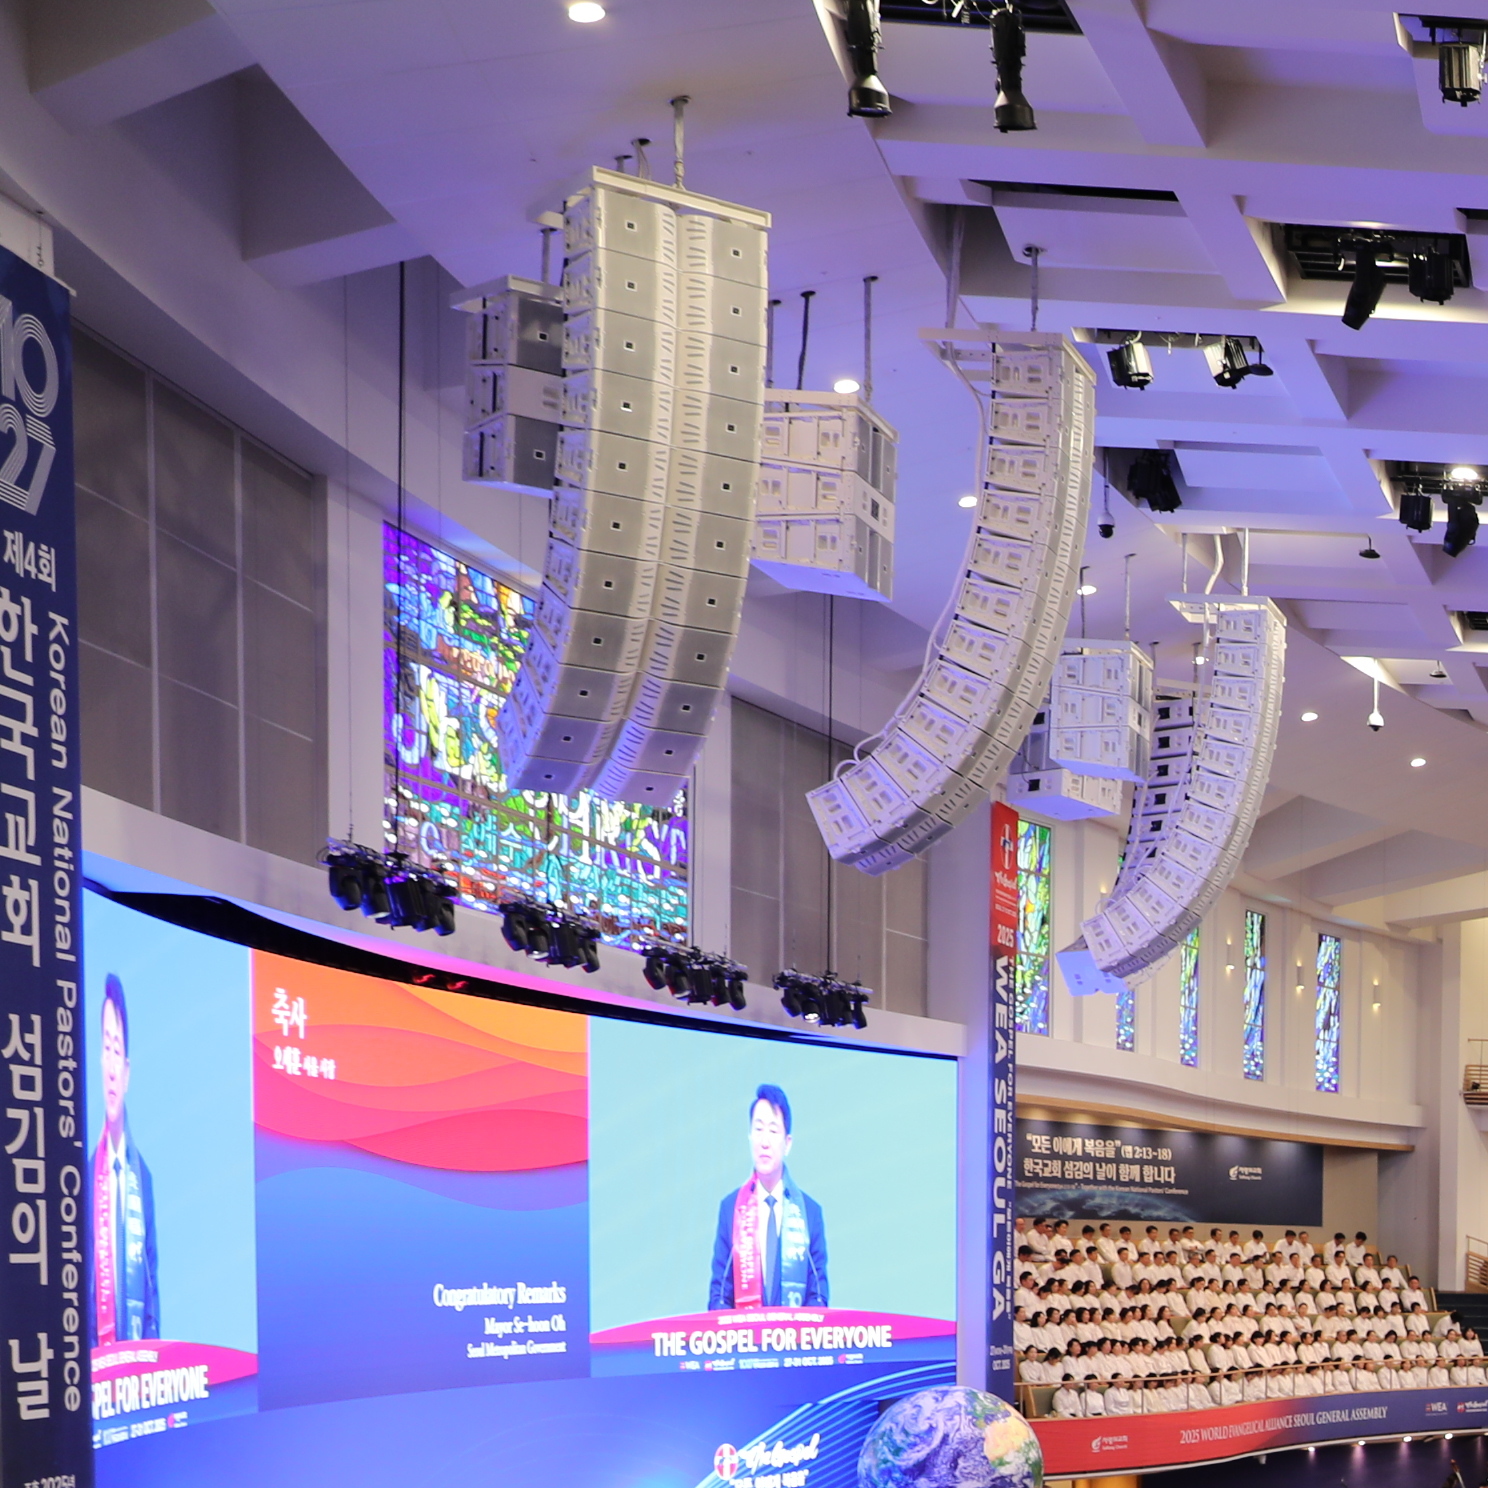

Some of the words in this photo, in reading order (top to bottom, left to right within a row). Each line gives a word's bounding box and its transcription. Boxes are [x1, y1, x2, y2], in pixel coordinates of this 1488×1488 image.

[4, 530, 56, 592] 제4회
[48, 611, 70, 769] Korean
[0, 586, 42, 967] 한국교회
[52, 787, 76, 962] National
[997, 923, 1015, 948] 2025
[271, 987, 308, 1039] 축사
[995, 955, 1008, 1064] WEA
[56, 979, 82, 1148] Pastors'
[2, 1013, 48, 1285] 섬김의
[993, 1077, 1007, 1238] SEOUL
[1006, 1101, 1014, 1190] EVERYONE
[1023, 1158, 1061, 1178] 한국교회
[1063, 1161, 1094, 1180] 섬김의
[1095, 1162, 1117, 1181] 날이
[1118, 1163, 1141, 1183] 함께
[1142, 1164, 1176, 1185] 합니다
[1052, 1136, 1083, 1156] 이에게
[59, 1165, 82, 1412] Conference
[433, 1283, 516, 1312] Congratulatory
[517, 1281, 567, 1305] Remarks
[992, 1250, 1005, 1321] GA
[9, 1333, 54, 1420] 날
[651, 1332, 687, 1357] THE
[689, 1328, 759, 1355] GOSPEL
[761, 1327, 798, 1352] FOR
[800, 1325, 893, 1351] EVERYONE
[115, 1375, 141, 1415] FOR
[141, 1364, 210, 1409] EVERYONE
[1179, 1429, 1200, 1444] 2025
[1201, 1426, 1229, 1442] WORLD
[1229, 1420, 1265, 1438] EVANGELICAL
[1294, 1412, 1316, 1427] SEOUL
[1316, 1409, 1350, 1424] GENERAL
[1350, 1406, 1388, 1421] ASSEMBLY
[1431, 1402, 1447, 1412] WEA
